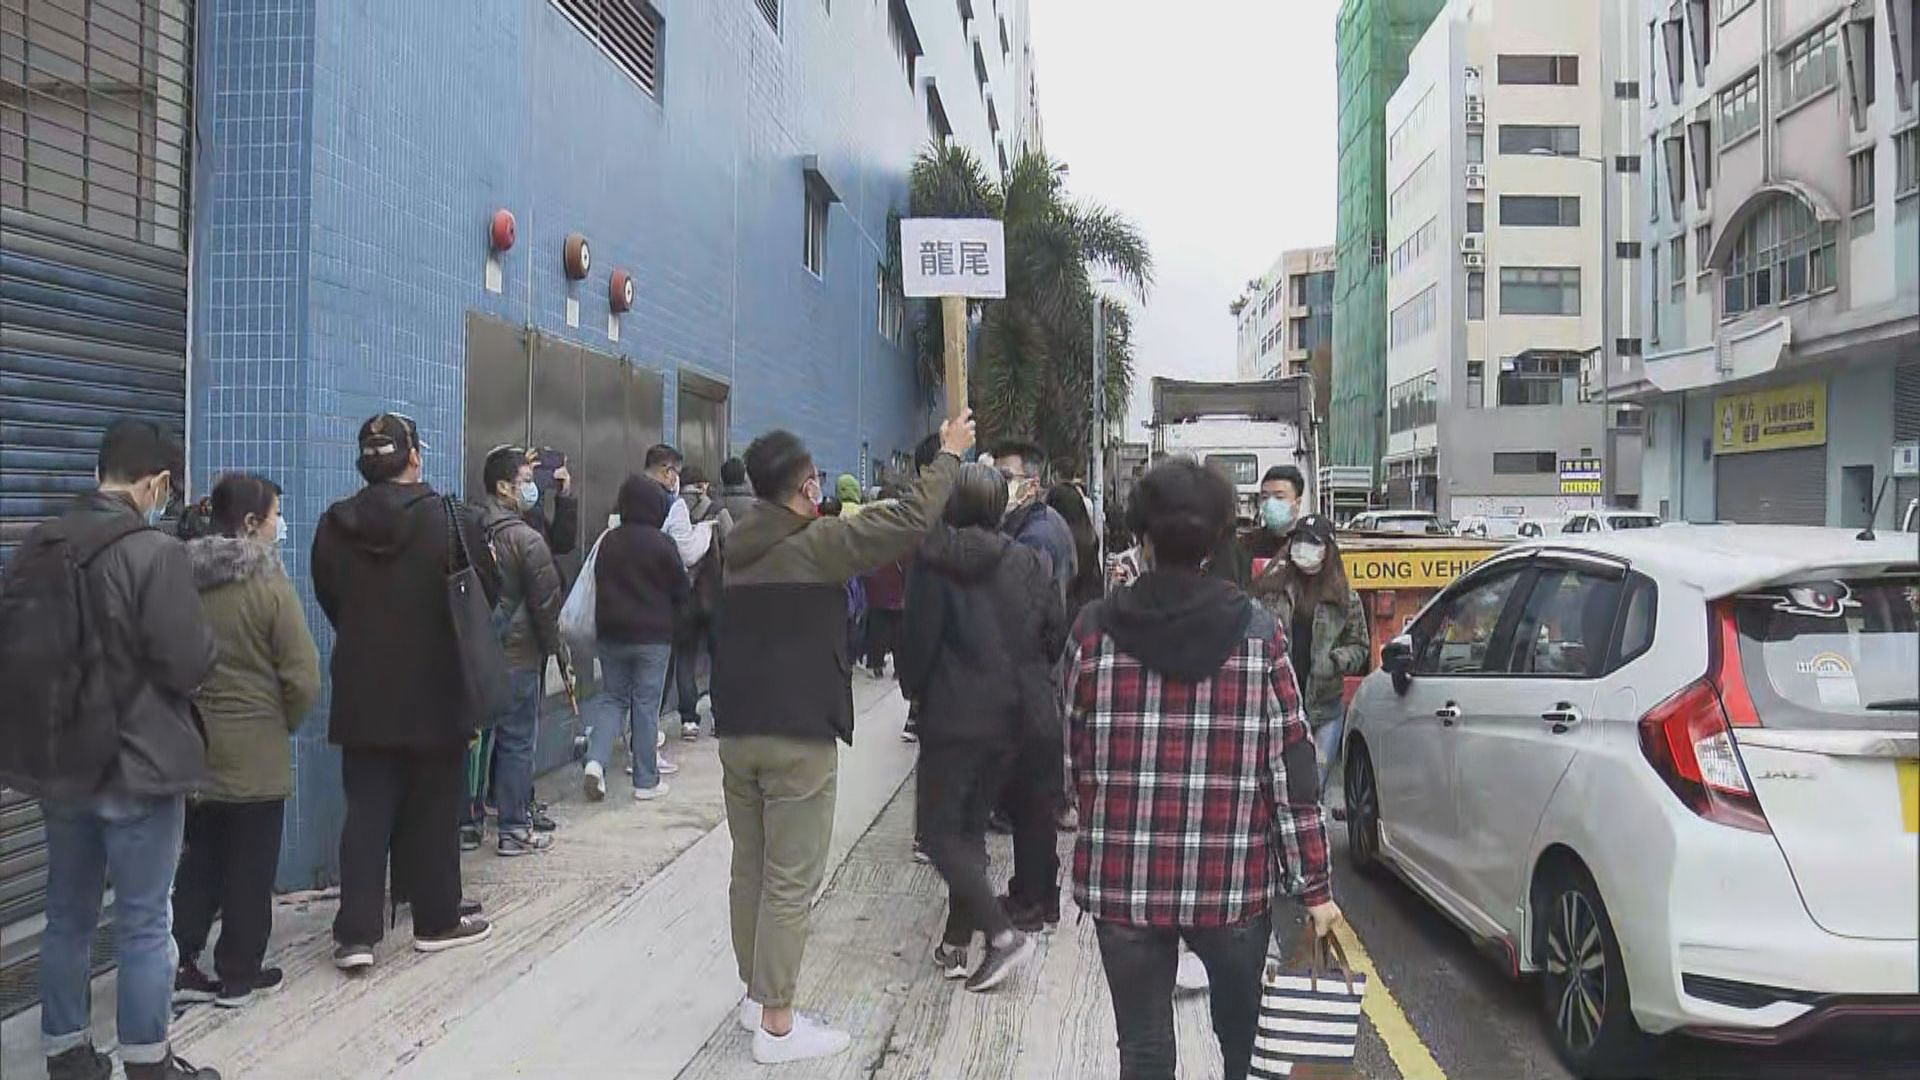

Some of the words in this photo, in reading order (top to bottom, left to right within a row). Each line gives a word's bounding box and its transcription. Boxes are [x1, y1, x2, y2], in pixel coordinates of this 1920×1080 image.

[920, 240, 990, 276] 龍尾
[1353, 561, 1412, 579] LONG
[1420, 559, 1480, 577] VEHI
